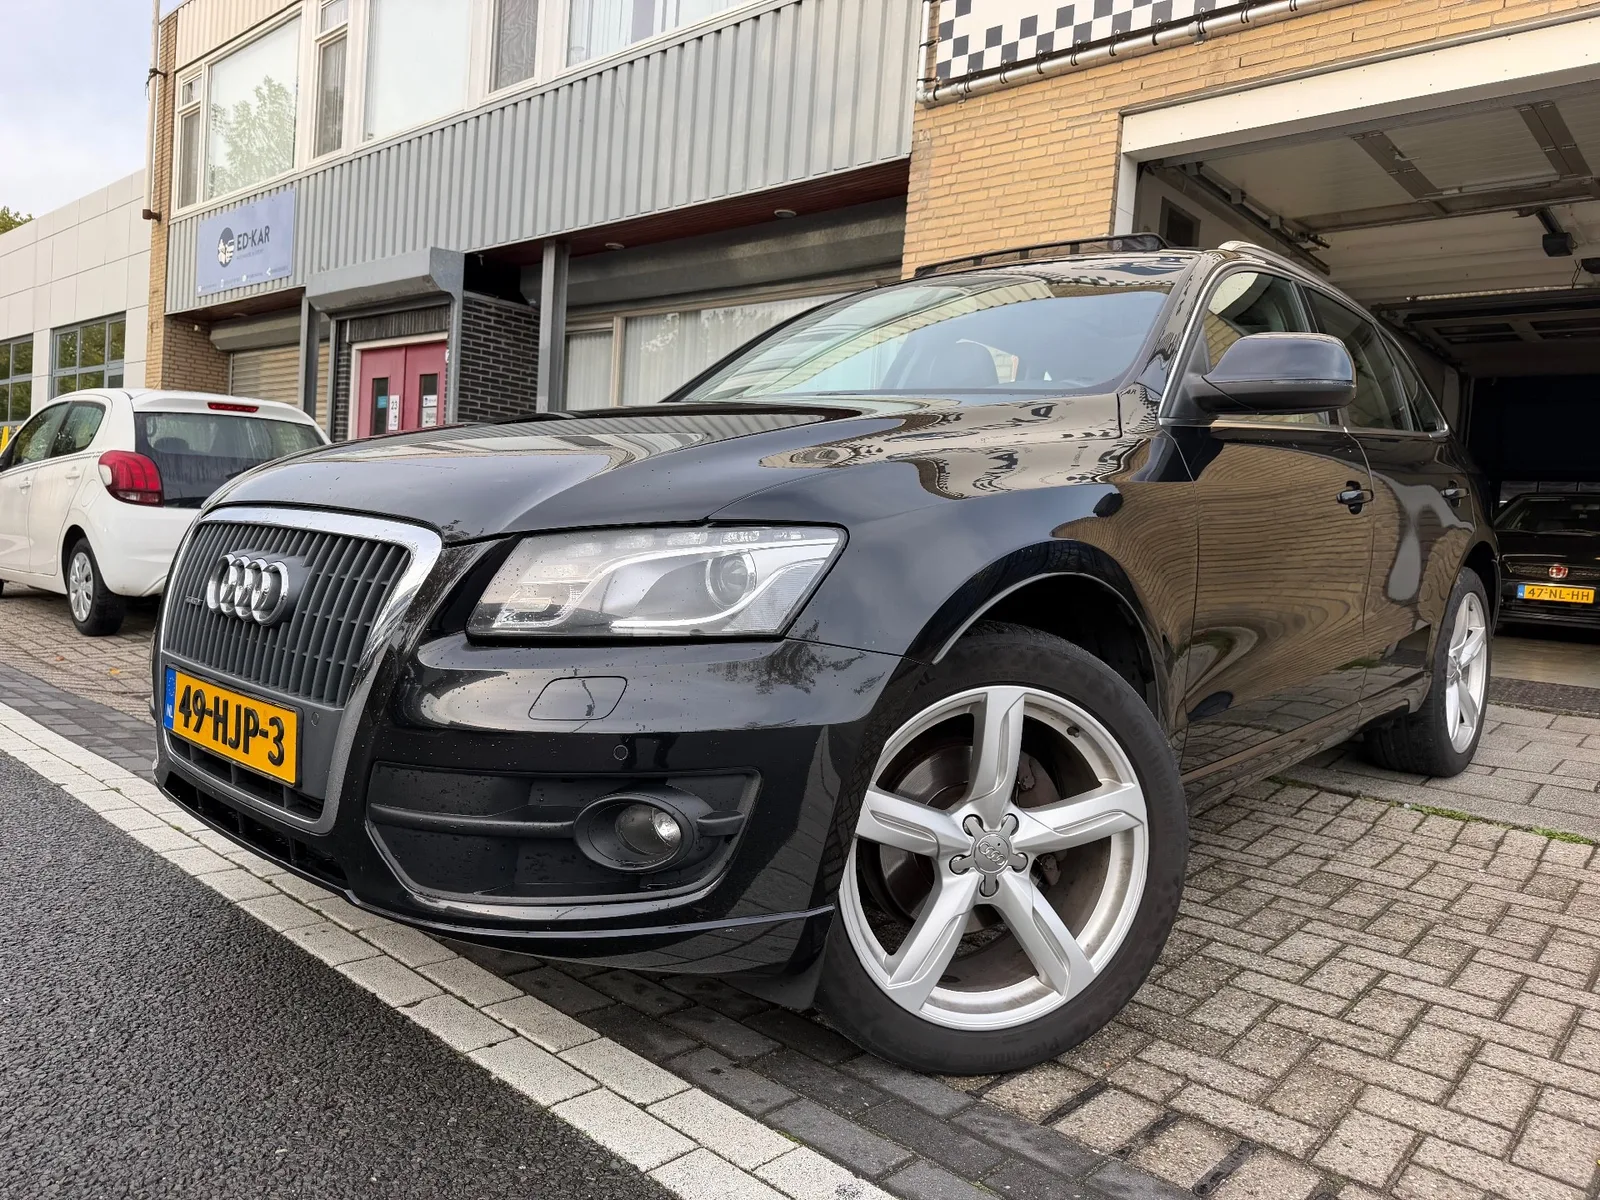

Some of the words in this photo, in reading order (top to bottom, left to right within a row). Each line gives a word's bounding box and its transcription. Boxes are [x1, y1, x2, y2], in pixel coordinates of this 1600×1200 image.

[237, 225, 270, 251] ED-KAR
[1528, 588, 1589, 601] 47-NL-HH
[179, 685, 284, 767] 49-HJP-3
